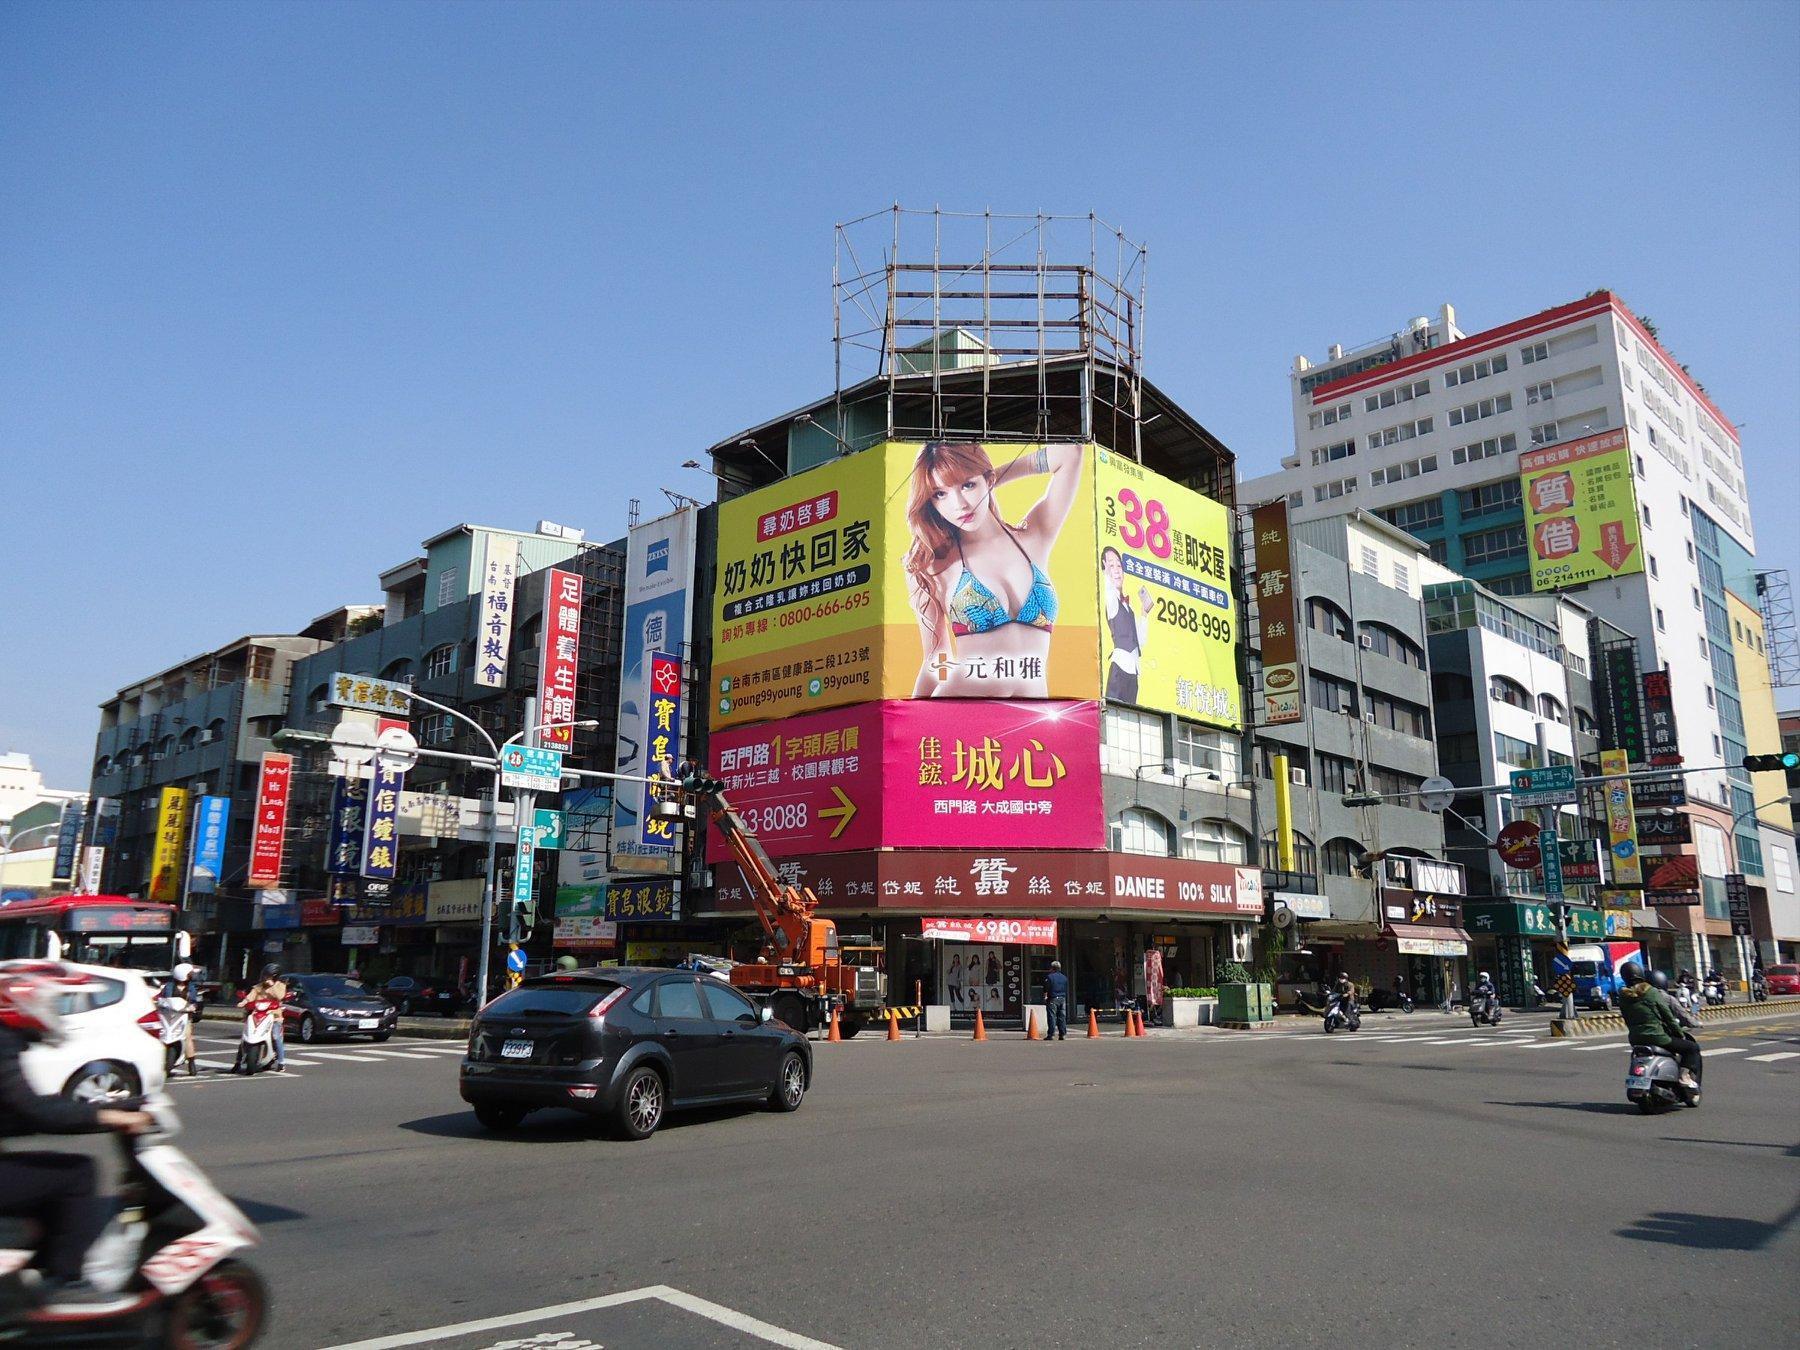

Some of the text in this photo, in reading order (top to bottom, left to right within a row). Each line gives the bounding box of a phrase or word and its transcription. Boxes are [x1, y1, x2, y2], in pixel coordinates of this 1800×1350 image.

[1118, 488, 1171, 559] 38
[647, 547, 669, 562] ZEISS
[723, 519, 871, 597] 奶奶快回家
[1185, 534, 1226, 582] 即交屋
[482, 591, 508, 684] 福音教會
[1156, 597, 1231, 644] 2988-999
[552, 576, 579, 722] 足體養生館
[732, 646, 870, 690] 台南市南區健康路二段123號
[965, 656, 1042, 680] 元和雅
[732, 670, 870, 711] young99young 99young
[951, 736, 1066, 791] 城心
[1652, 745, 1677, 755] PAWN
[1518, 777, 1529, 787] 21
[934, 799, 1053, 815] 西門路 大成國中旁
[607, 886, 672, 917] 寶島眼鏡
[1115, 875, 1165, 899] DANEE
[1178, 882, 1204, 901] 100%
[1210, 884, 1232, 903] SILK
[976, 920, 1021, 936] 6980
